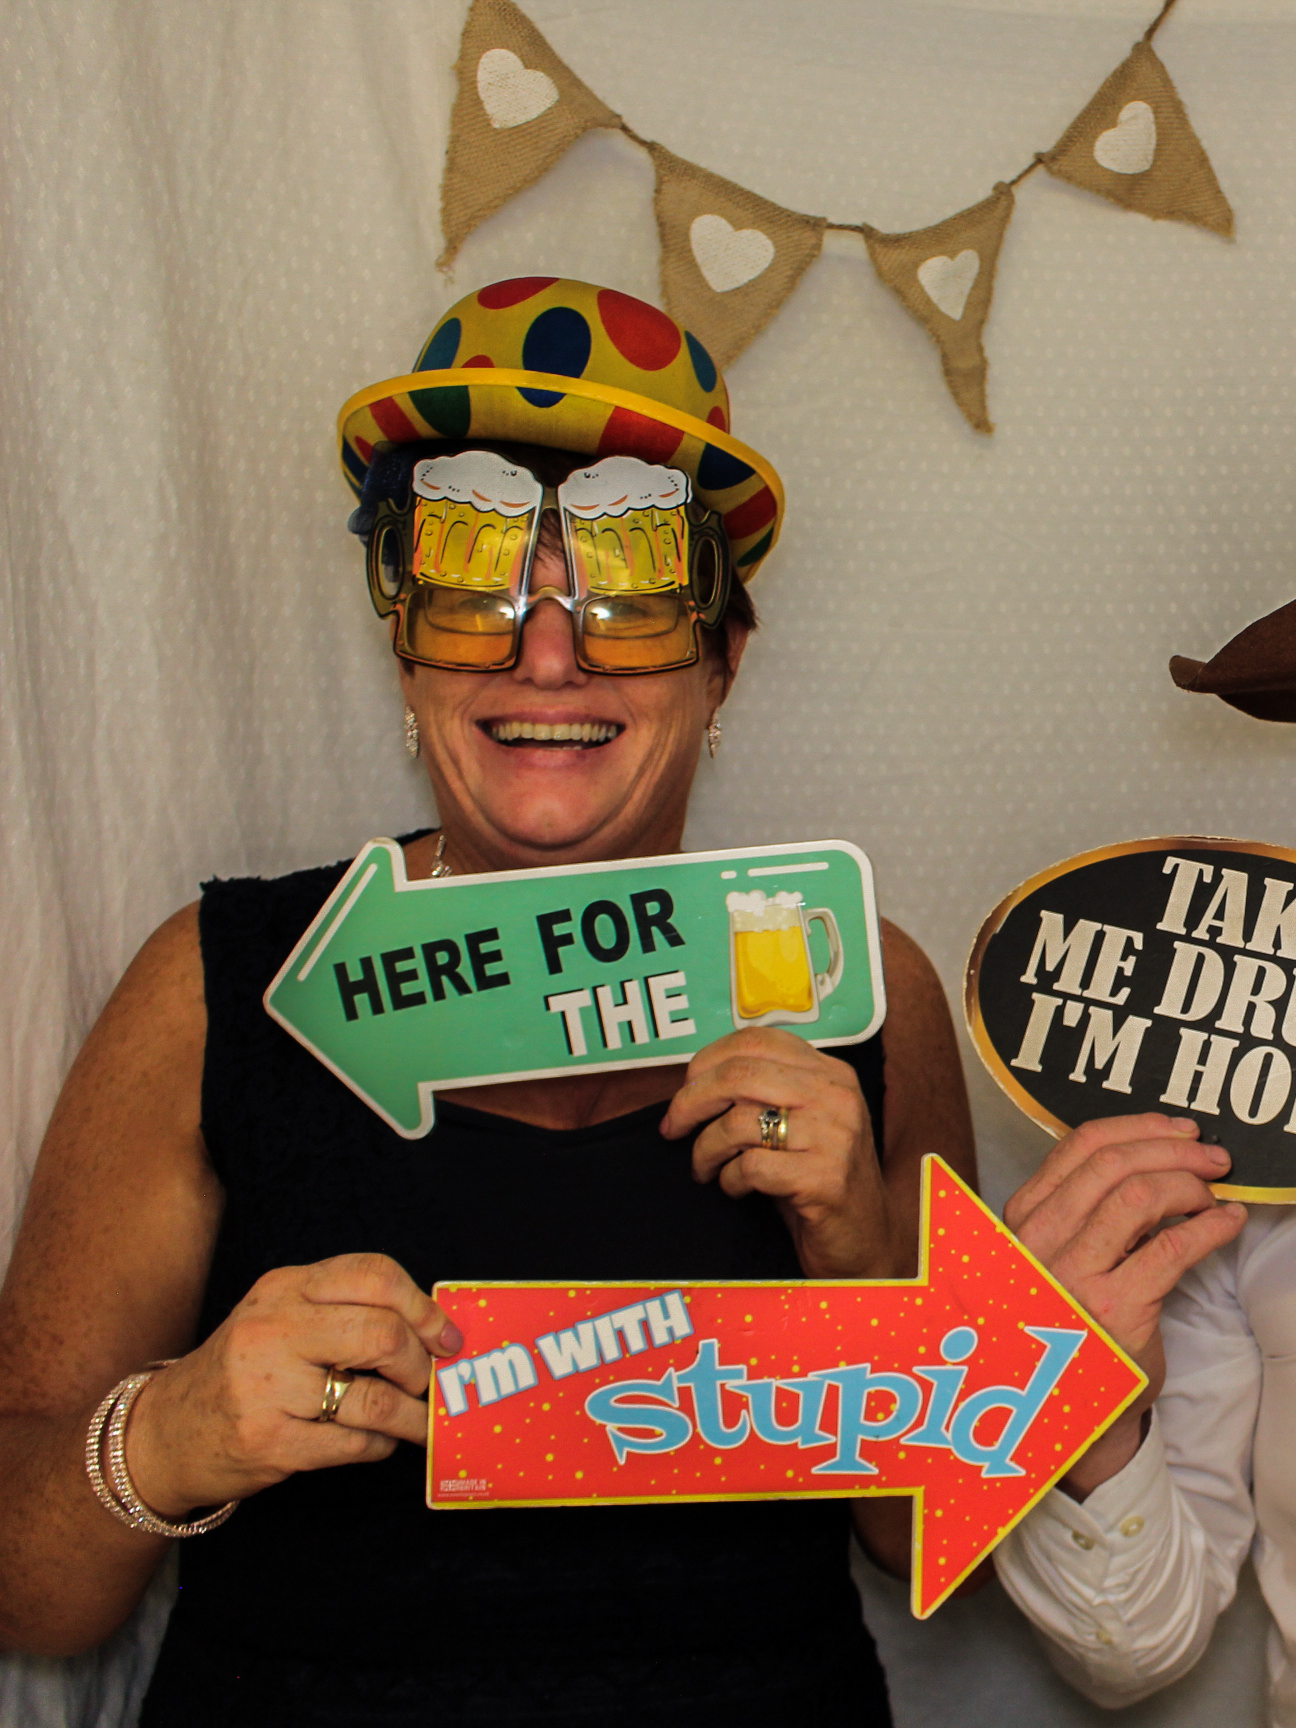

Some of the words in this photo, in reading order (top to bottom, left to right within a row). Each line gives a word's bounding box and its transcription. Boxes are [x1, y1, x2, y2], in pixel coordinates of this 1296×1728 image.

[332, 927, 511, 1022] HERE
[536, 888, 686, 975] FOR
[1020, 909, 1144, 1006] ME
[545, 970, 697, 1058] THE
[1010, 992, 1152, 1095] I'M
[535, 1289, 694, 1382] WITH
[585, 1326, 1088, 1478] stupid
